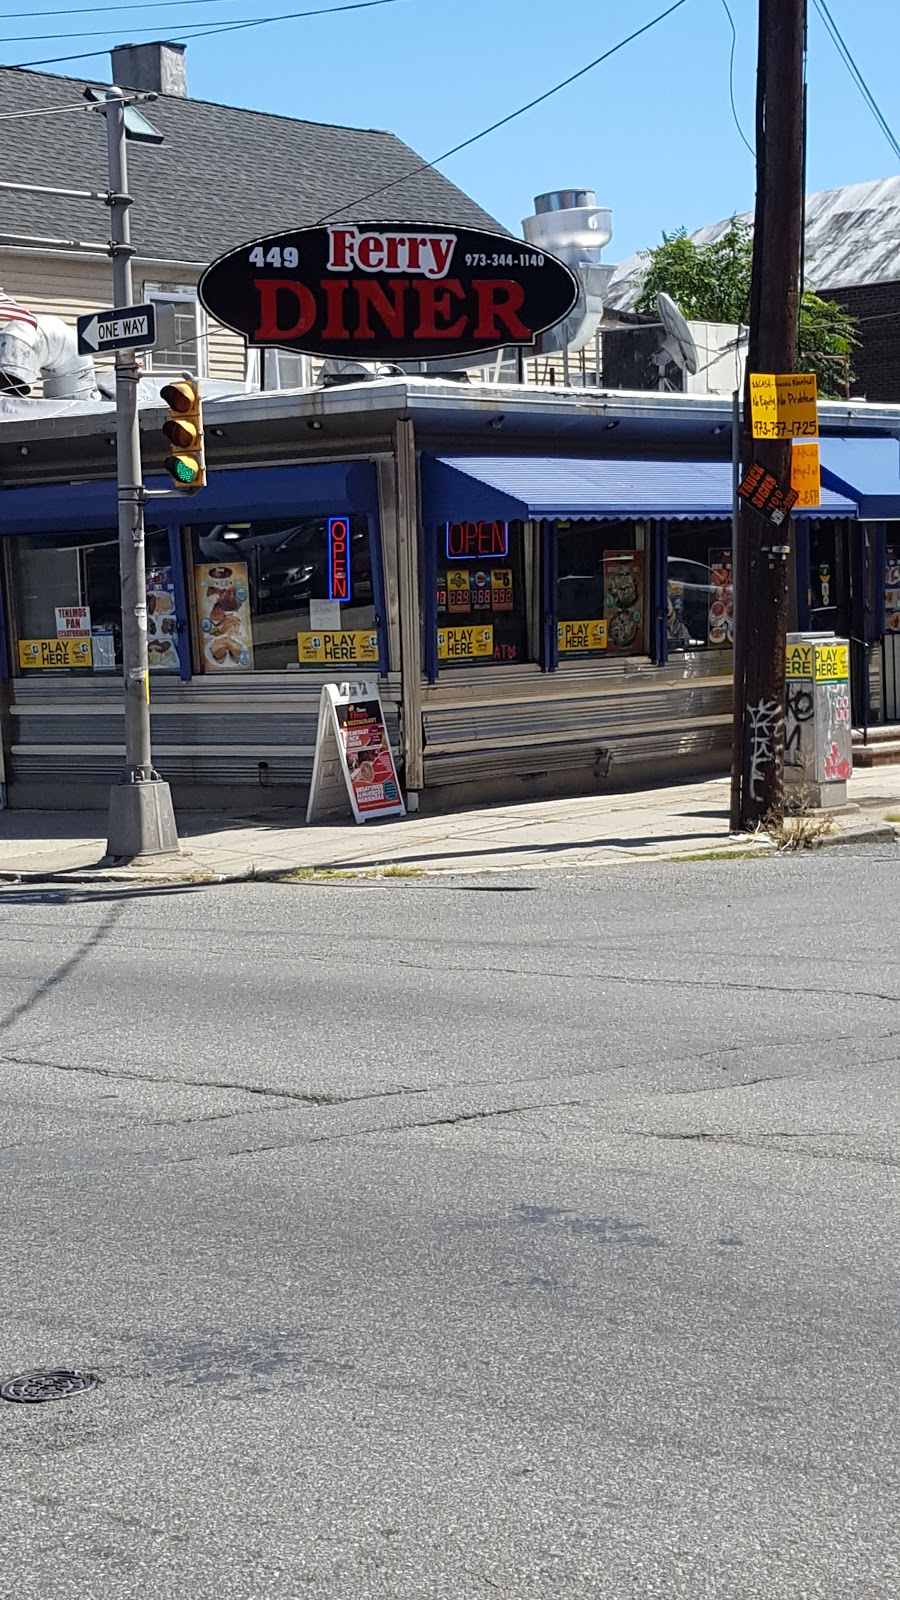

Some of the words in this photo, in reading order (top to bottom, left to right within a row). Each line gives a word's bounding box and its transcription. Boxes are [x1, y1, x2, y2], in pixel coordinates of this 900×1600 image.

[248, 245, 299, 269] 449
[328, 228, 456, 277] Ferry
[463, 252, 546, 268] 973-344-1140
[253, 278, 534, 341] DINER
[98, 322, 119, 339] ONE
[122, 318, 146, 336] WAY
[738, 463, 766, 498] TRUCK
[752, 474, 777, 509] SIGNS
[449, 521, 506, 554] OPEN
[331, 521, 347, 598] OPEN
[57, 608, 87, 619] TENEMOS
[65, 618, 81, 629] PAN
[565, 623, 590, 637] PLAY
[323, 634, 357, 648] PLAY
[447, 629, 474, 643] PLAY
[565, 635, 589, 649] HERE
[41, 641, 69, 654] PLAY
[324, 646, 358, 660] HERE
[447, 641, 474, 656] HERE
[786, 647, 812, 662] AY
[41, 652, 70, 665] HERE
[815, 649, 838, 663] PLAY
[786, 660, 812, 675] ERE
[815, 662, 838, 676] HERE
